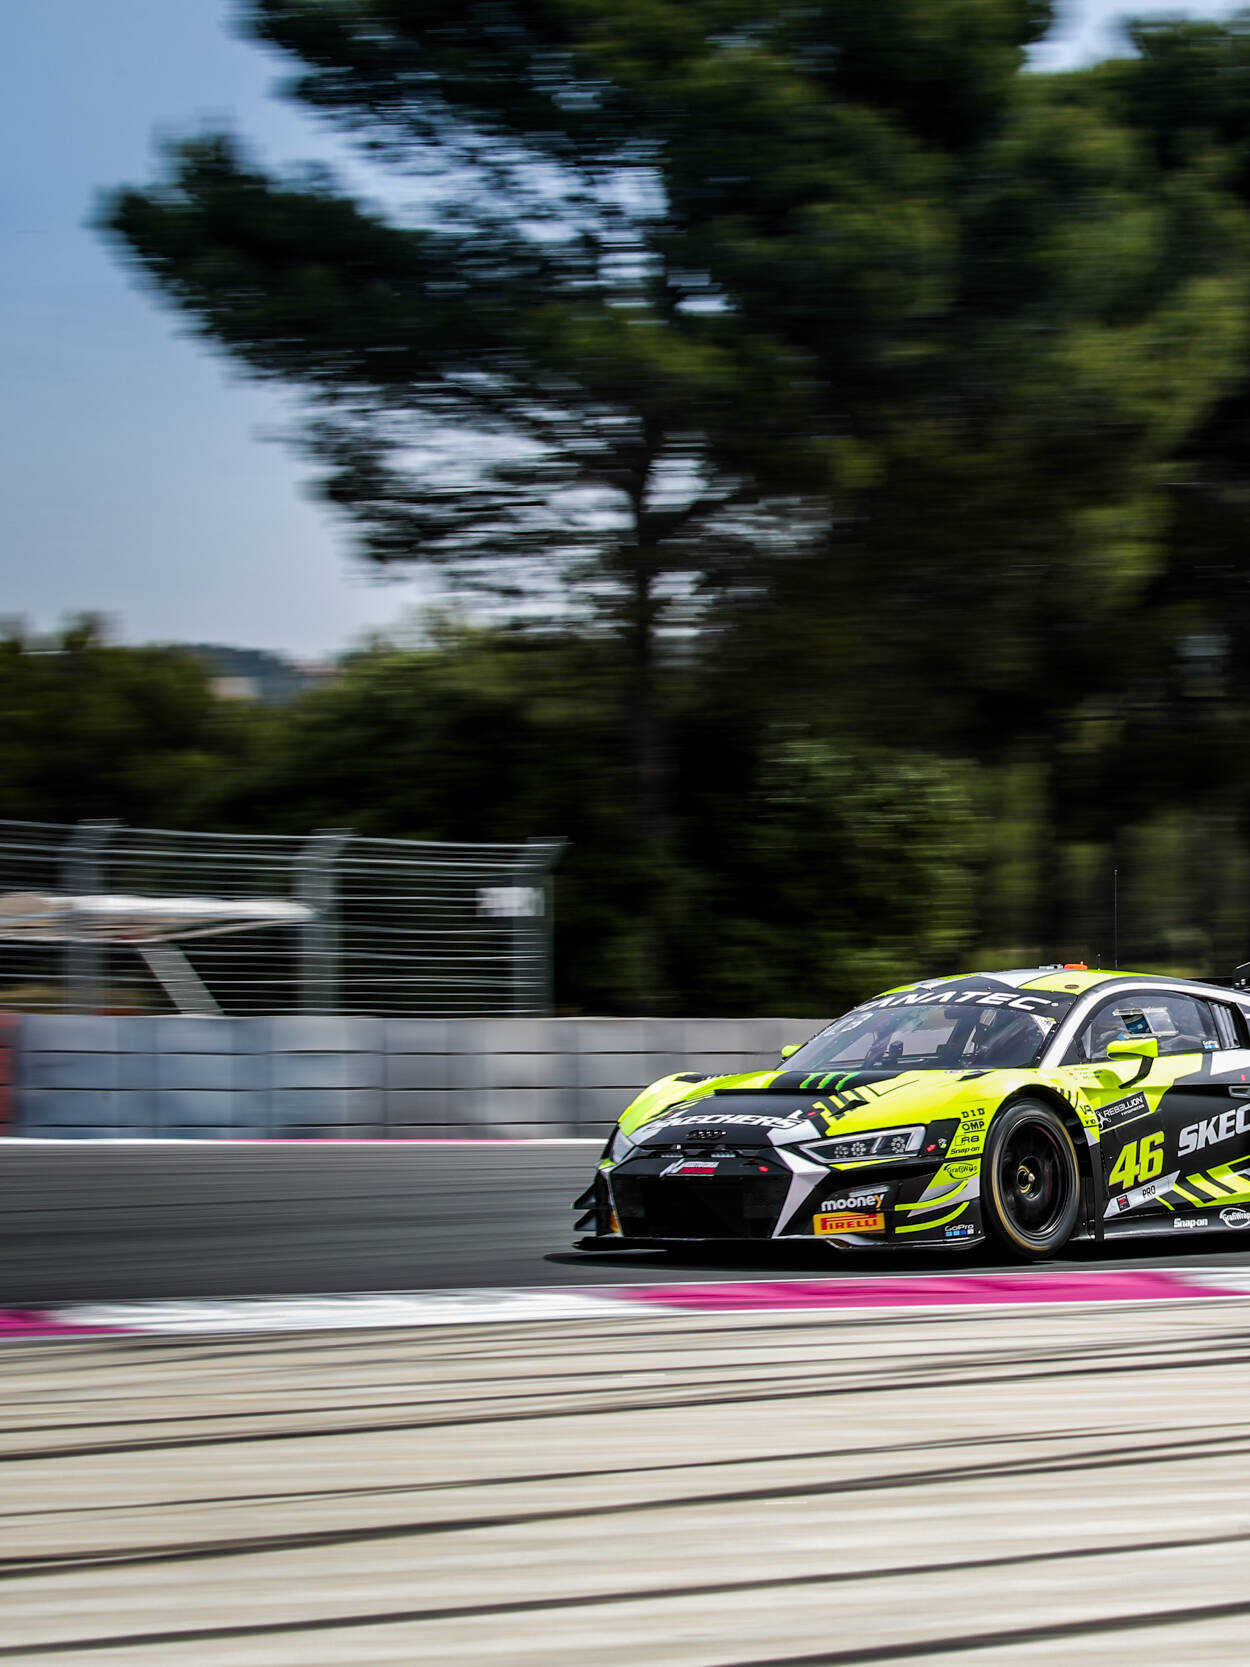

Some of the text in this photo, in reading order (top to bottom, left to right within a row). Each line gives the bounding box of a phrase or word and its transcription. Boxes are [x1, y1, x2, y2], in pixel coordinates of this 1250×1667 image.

[961, 1108, 986, 1119] DID
[962, 1121, 985, 1131] OMP
[1108, 1131, 1165, 1190] 46
[1142, 1185, 1156, 1198] PRO
[821, 1193, 885, 1212] mooney
[820, 1213, 878, 1231] PIRELLI
[1173, 1218, 1209, 1229] Snap-on
